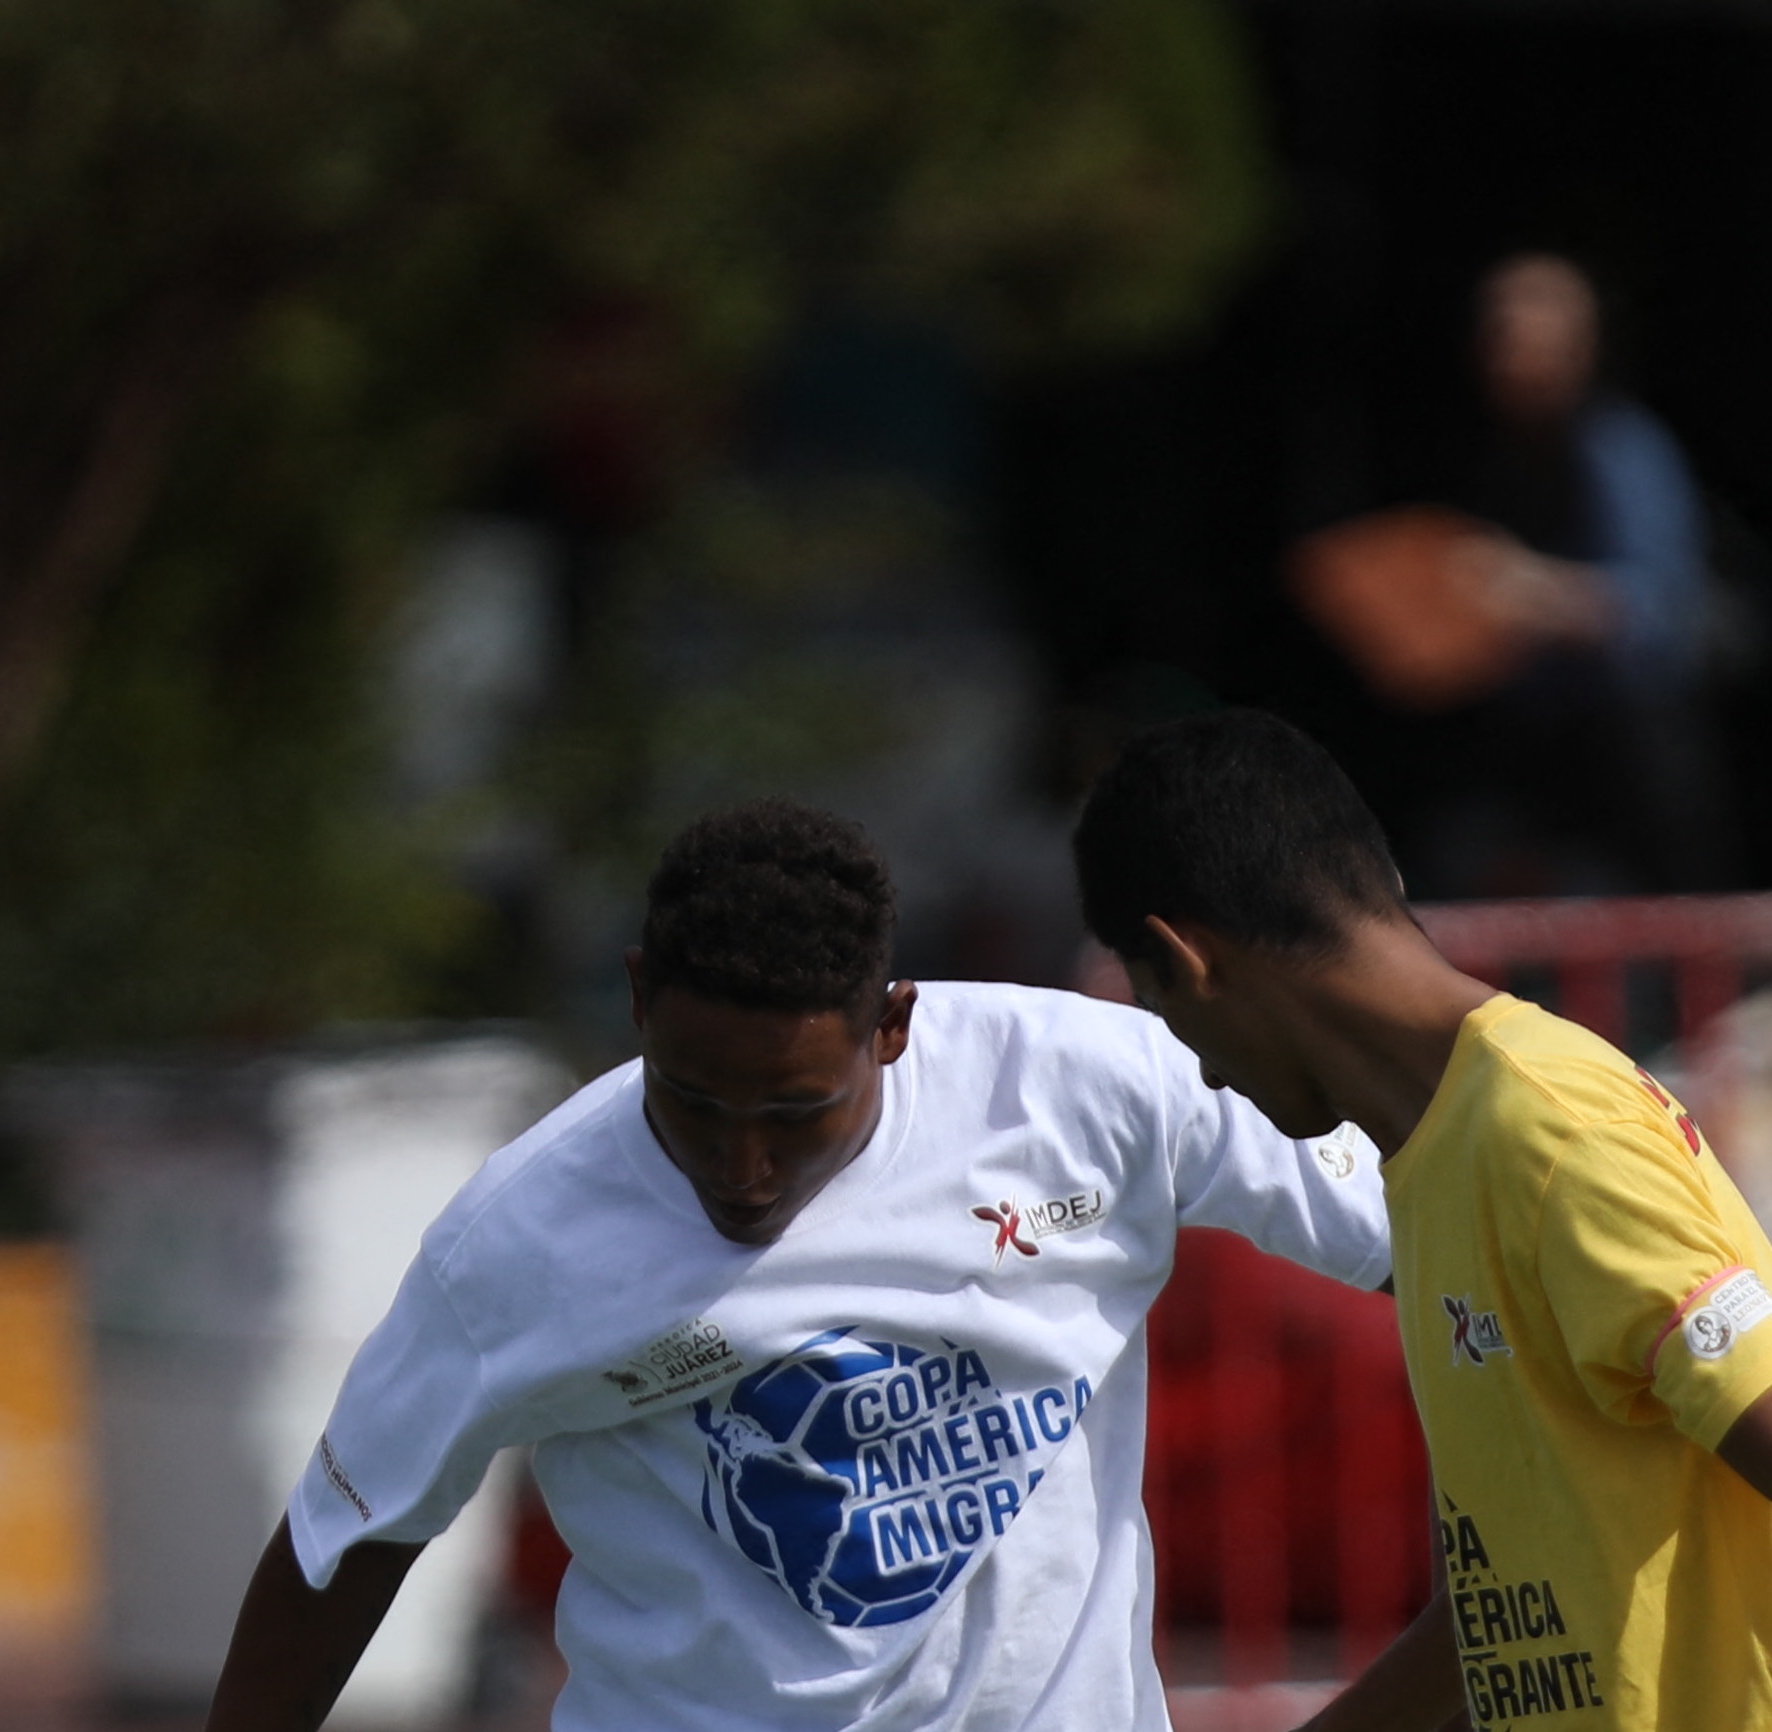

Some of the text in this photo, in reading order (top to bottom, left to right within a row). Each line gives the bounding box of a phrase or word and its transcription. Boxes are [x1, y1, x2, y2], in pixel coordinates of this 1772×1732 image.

[1024, 1189, 1102, 1231] IMDEJ
[650, 1324, 721, 1366] CIUDAD
[665, 1339, 734, 1380] JUÁREZ
[850, 1348, 992, 1436] COPA
[876, 1467, 1045, 1568] MIGR
